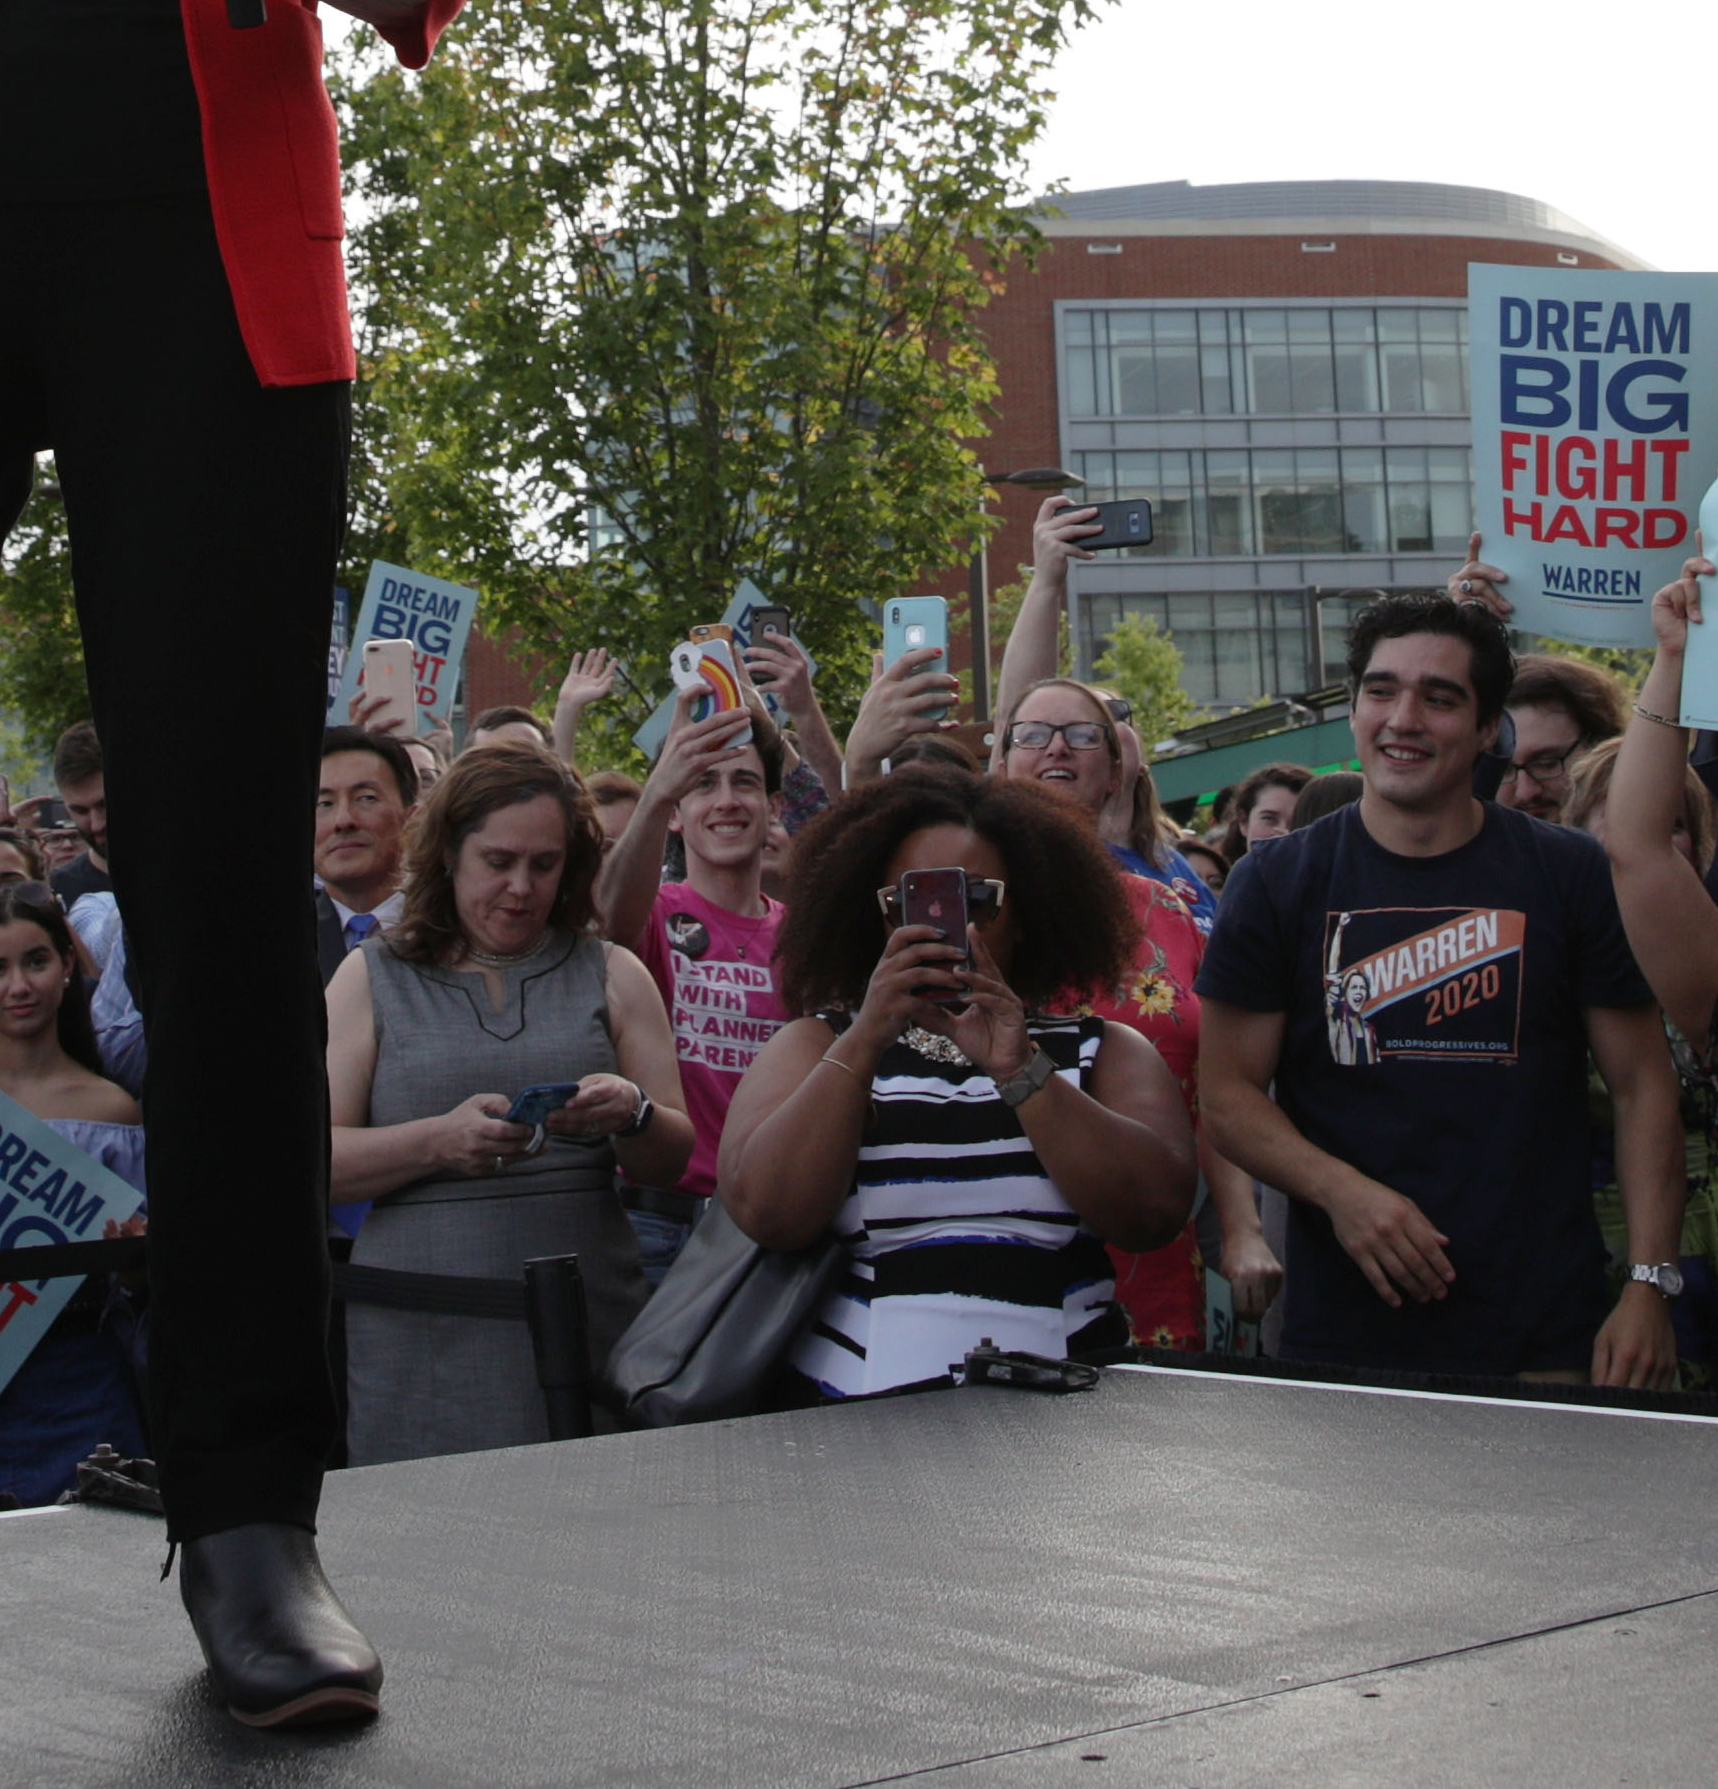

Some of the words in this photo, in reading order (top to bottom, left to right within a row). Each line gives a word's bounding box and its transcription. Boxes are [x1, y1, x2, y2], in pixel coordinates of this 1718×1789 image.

[1500, 296, 1691, 354] DREAM
[1500, 353, 1689, 434] BIG
[1500, 430, 1690, 502] FIGHT
[1503, 496, 1688, 550] HARD
[379, 577, 461, 623] DREAM
[1542, 563, 1642, 596] WARREN
[370, 603, 453, 657] BIG
[1362, 911, 1498, 1000] WARREN
[678, 984, 742, 1011] WITH
[1423, 964, 1502, 1026] 2020
[676, 1036, 759, 1069] PAREN
[1385, 1039, 1509, 1051] BOLDPROGRESSIVES.ORG
